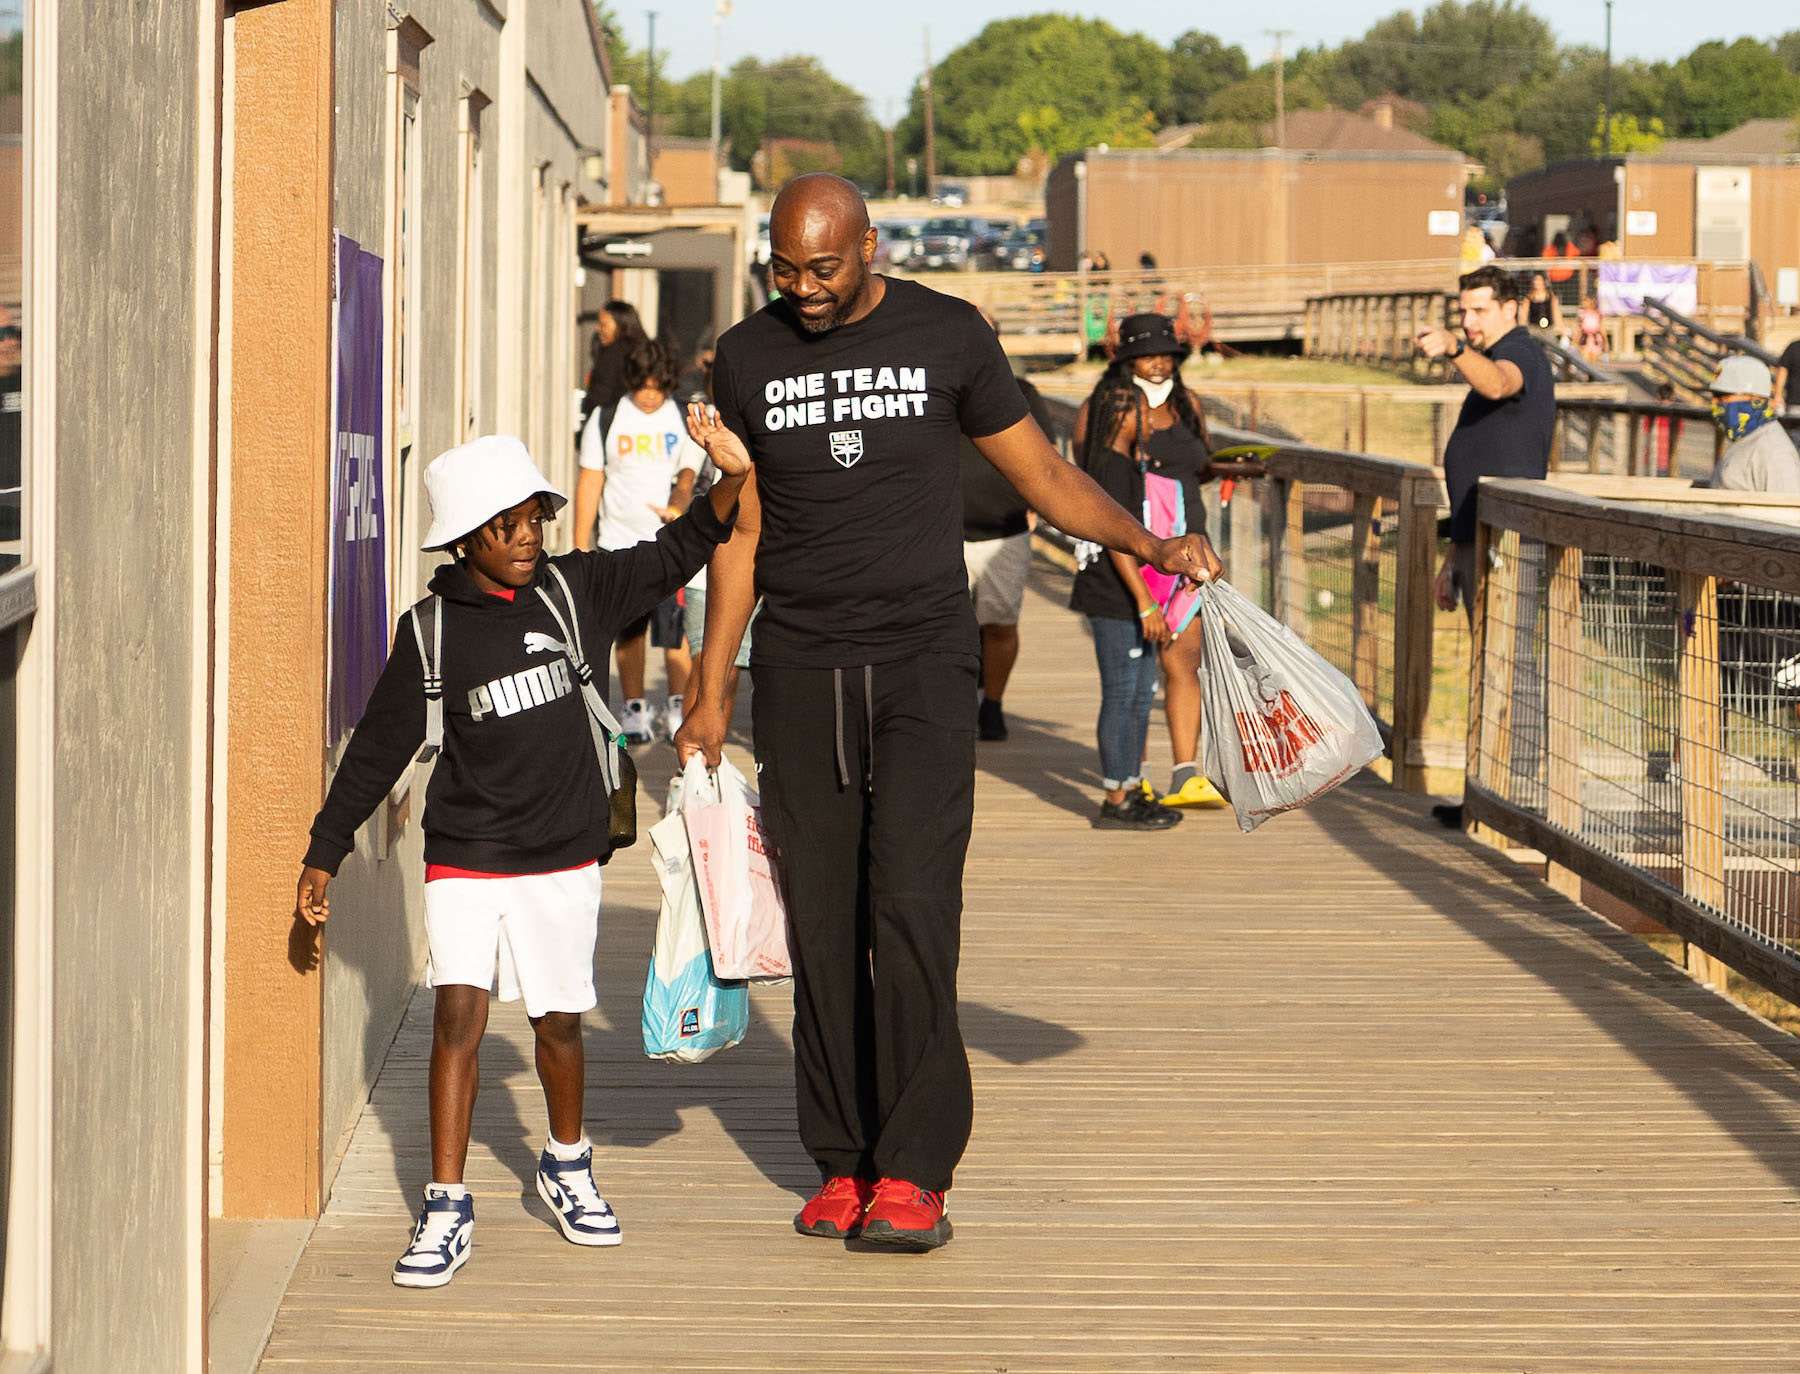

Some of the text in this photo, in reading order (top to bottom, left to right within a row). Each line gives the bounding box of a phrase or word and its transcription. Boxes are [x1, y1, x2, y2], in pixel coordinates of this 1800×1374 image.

[765, 367, 926, 404] ONE TEAM
[765, 393, 928, 431] ONE FIGHT
[618, 432, 678, 456] DRIP
[467, 658, 572, 722] PUMA
